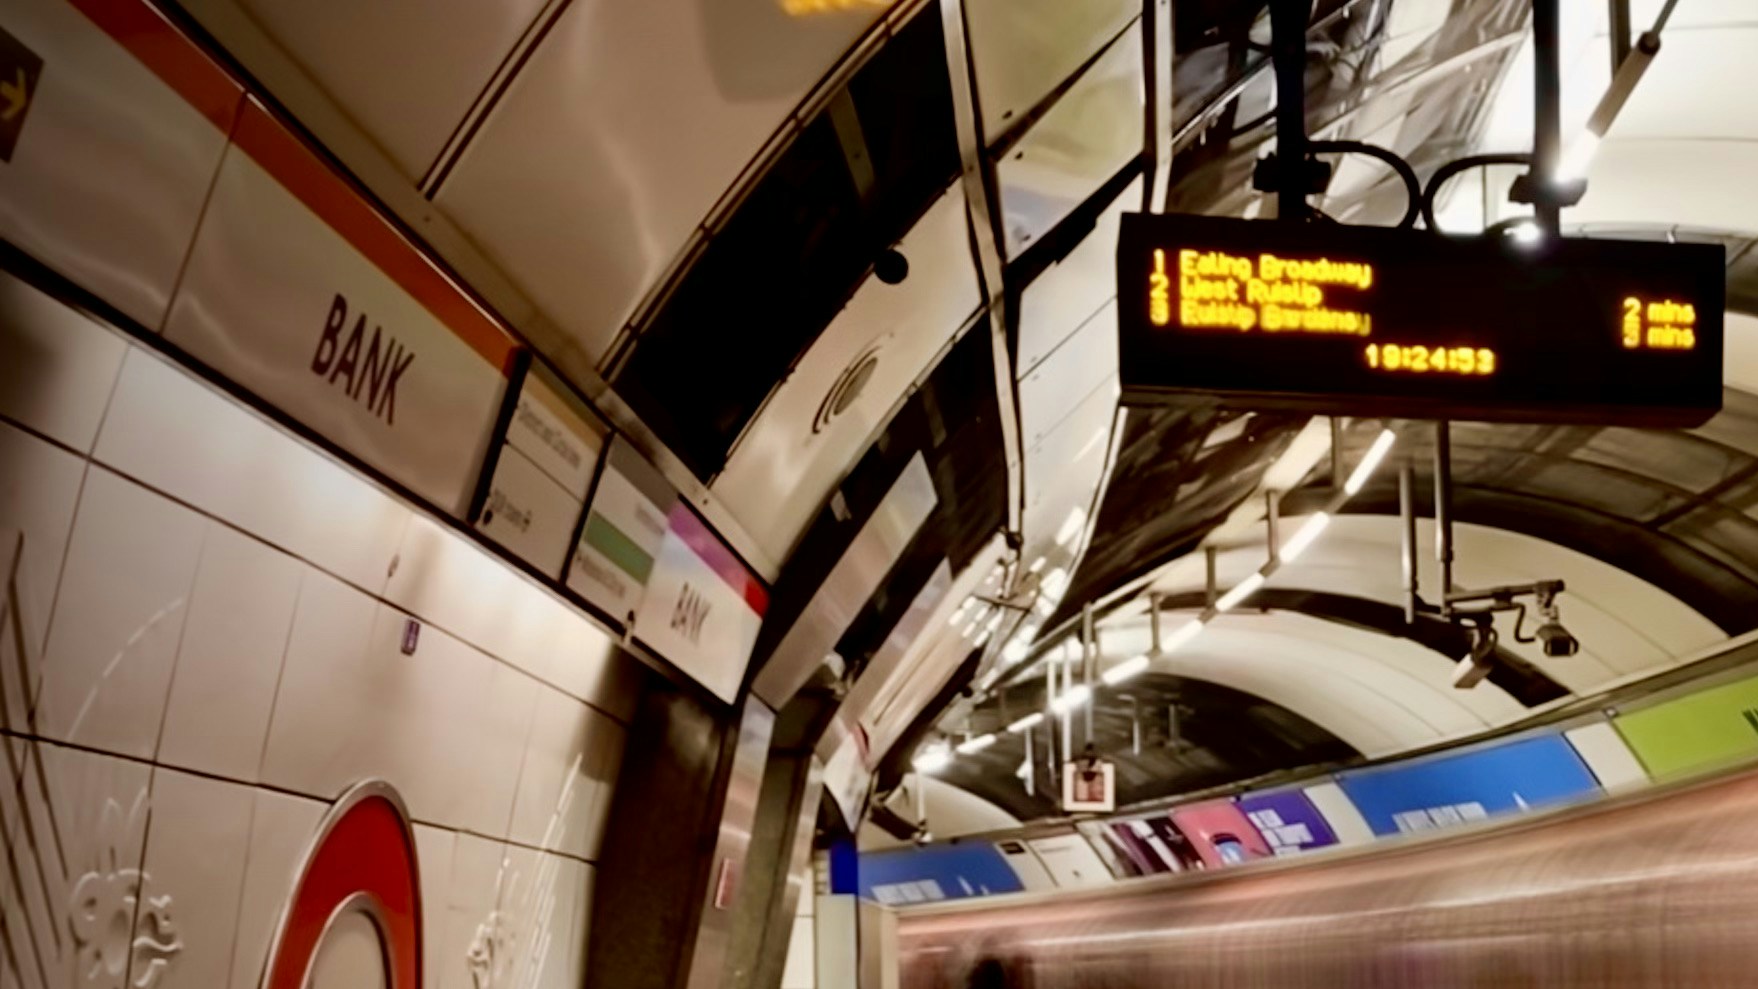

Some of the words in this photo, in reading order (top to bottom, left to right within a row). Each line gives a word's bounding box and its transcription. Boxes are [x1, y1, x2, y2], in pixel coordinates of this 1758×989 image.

[1179, 249, 1252, 282] Ealing
[1258, 254, 1372, 289] Broadway
[1150, 273, 1169, 299] 2
[1180, 276, 1239, 301] West
[1246, 278, 1323, 308] Ruislip
[1623, 296, 1641, 322] 2
[1647, 298, 1696, 324] mins
[310, 292, 415, 427] BANK
[1647, 323, 1696, 349] mins
[669, 581, 713, 647] BANK
